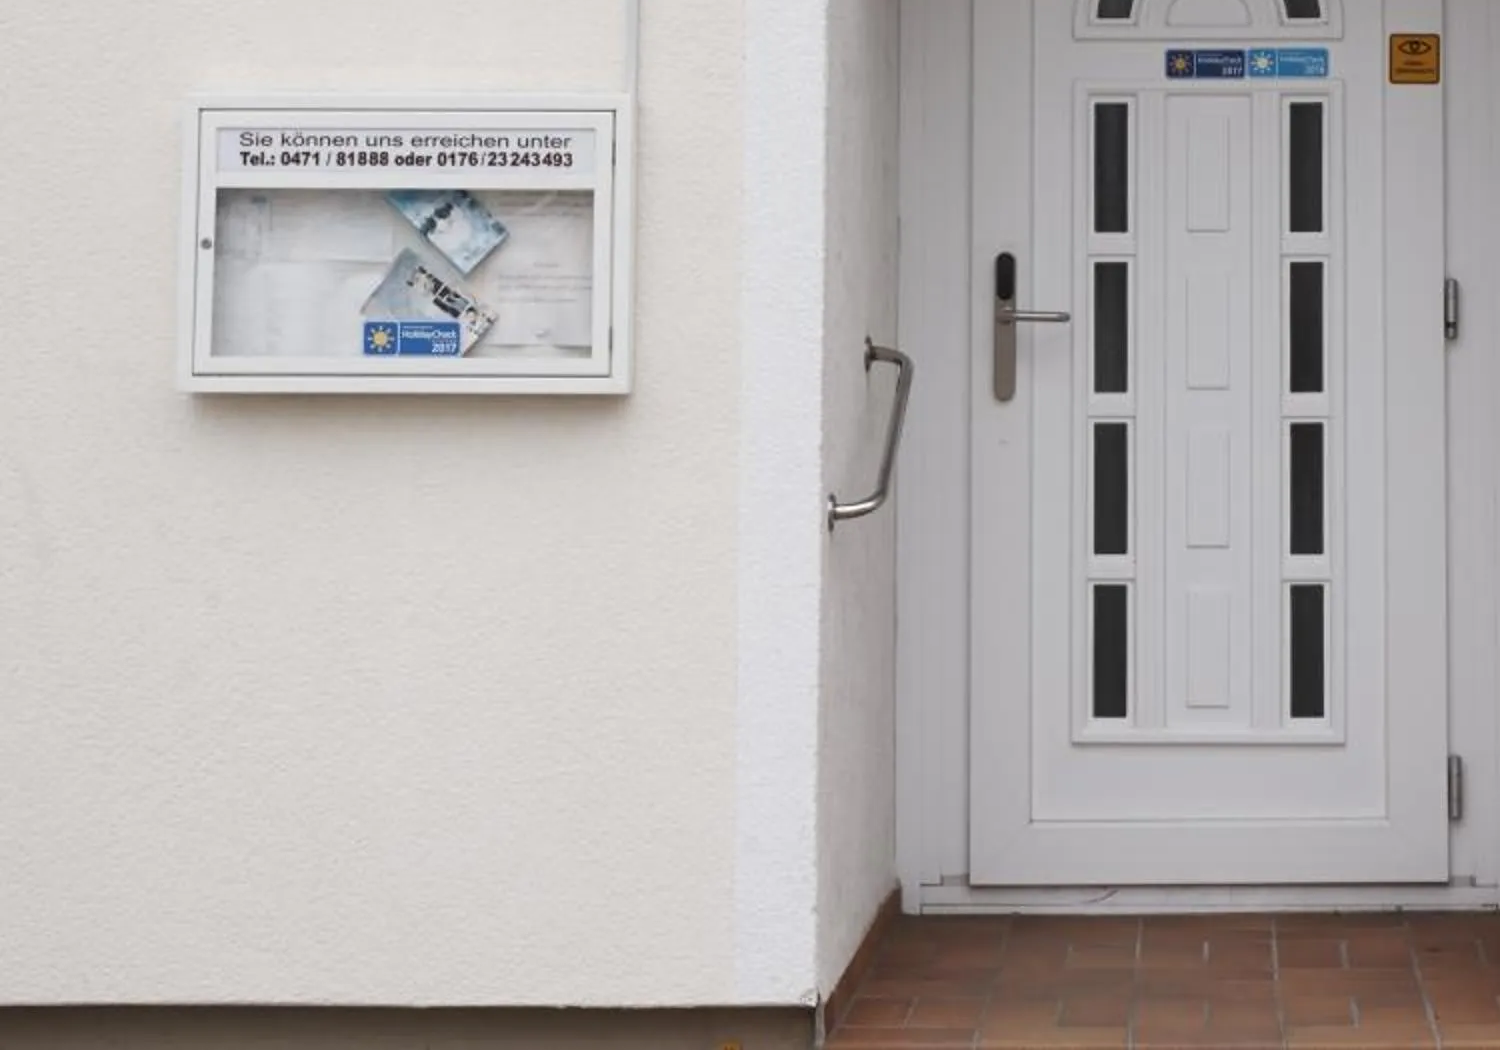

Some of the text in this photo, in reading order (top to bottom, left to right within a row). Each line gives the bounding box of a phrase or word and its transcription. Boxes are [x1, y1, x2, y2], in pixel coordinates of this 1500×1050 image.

[239, 131, 572, 149] Sie können uns erreichen unter
[239, 151, 275, 167] Tel.:
[280, 151, 320, 167] 0471
[336, 151, 389, 167] 81888
[394, 151, 432, 167] oder
